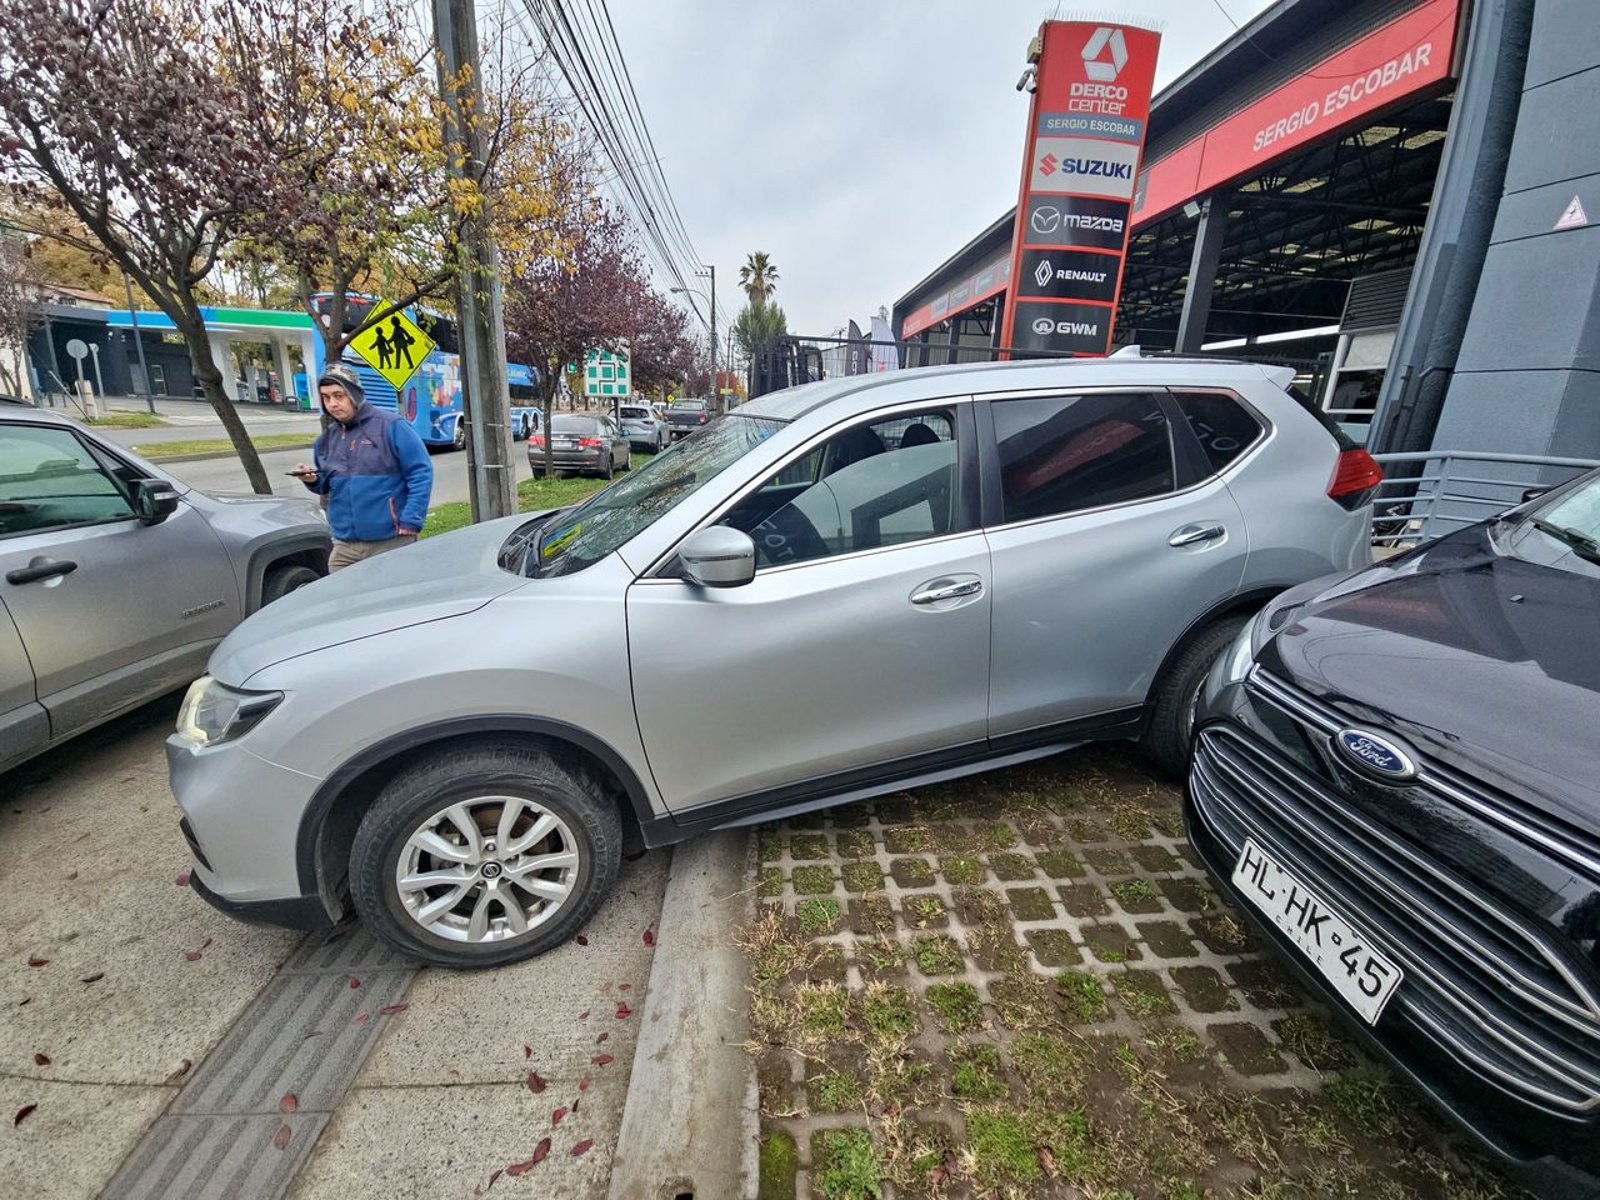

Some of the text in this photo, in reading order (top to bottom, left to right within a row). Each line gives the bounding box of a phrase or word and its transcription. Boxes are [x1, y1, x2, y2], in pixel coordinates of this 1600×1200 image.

[1069, 83, 1128, 100] DERCO
[1252, 42, 1433, 152] SERGIO ESCOBAR
[1068, 99, 1126, 115] center
[1047, 119, 1136, 136] SERGIO ESCOBAR
[1061, 158, 1132, 180] SUZUKI
[1063, 214, 1123, 233] mazda
[1056, 269, 1107, 282] RENAULT
[1056, 322, 1097, 336] GWM
[1350, 738, 1393, 766] Ford
